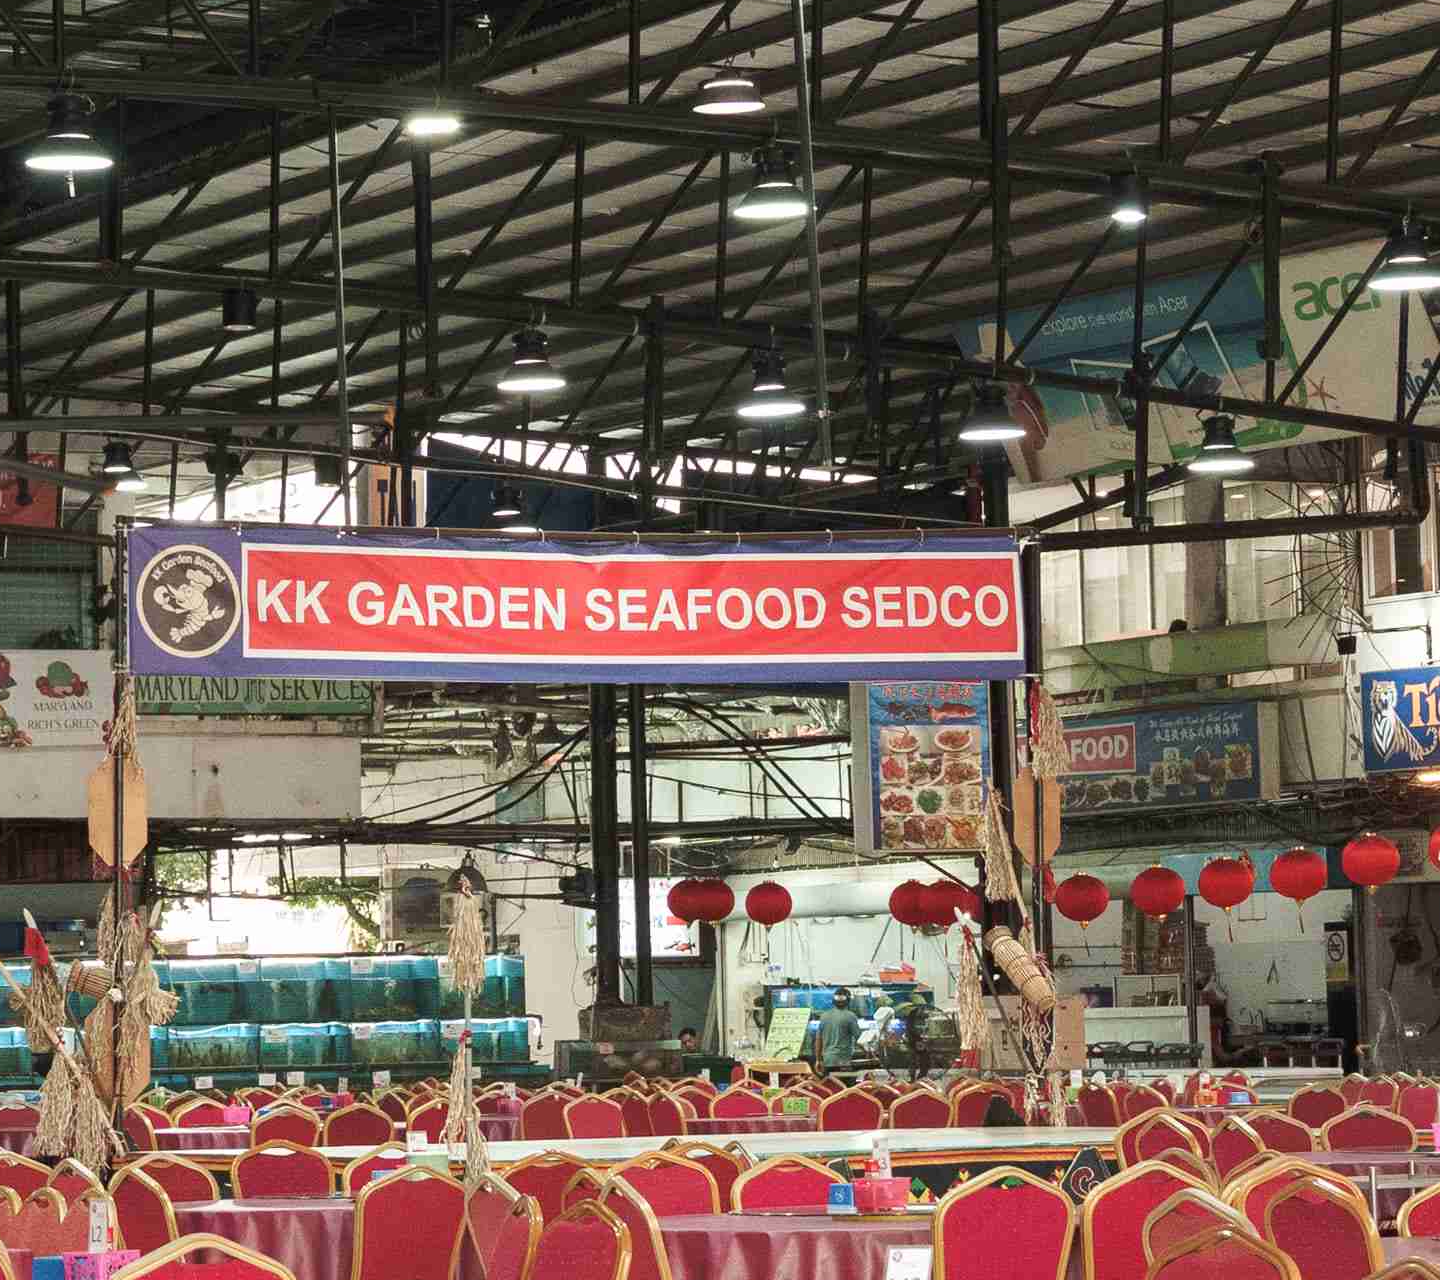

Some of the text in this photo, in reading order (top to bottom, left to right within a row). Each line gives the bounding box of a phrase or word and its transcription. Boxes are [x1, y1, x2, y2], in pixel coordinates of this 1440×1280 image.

[254, 579, 1009, 633] KK GARDEN SEAFOOD SEDCO
[135, 677, 239, 702] MARYLAND
[1071, 733, 1130, 762] FOOD
[91, 1222, 103, 1242] L2
